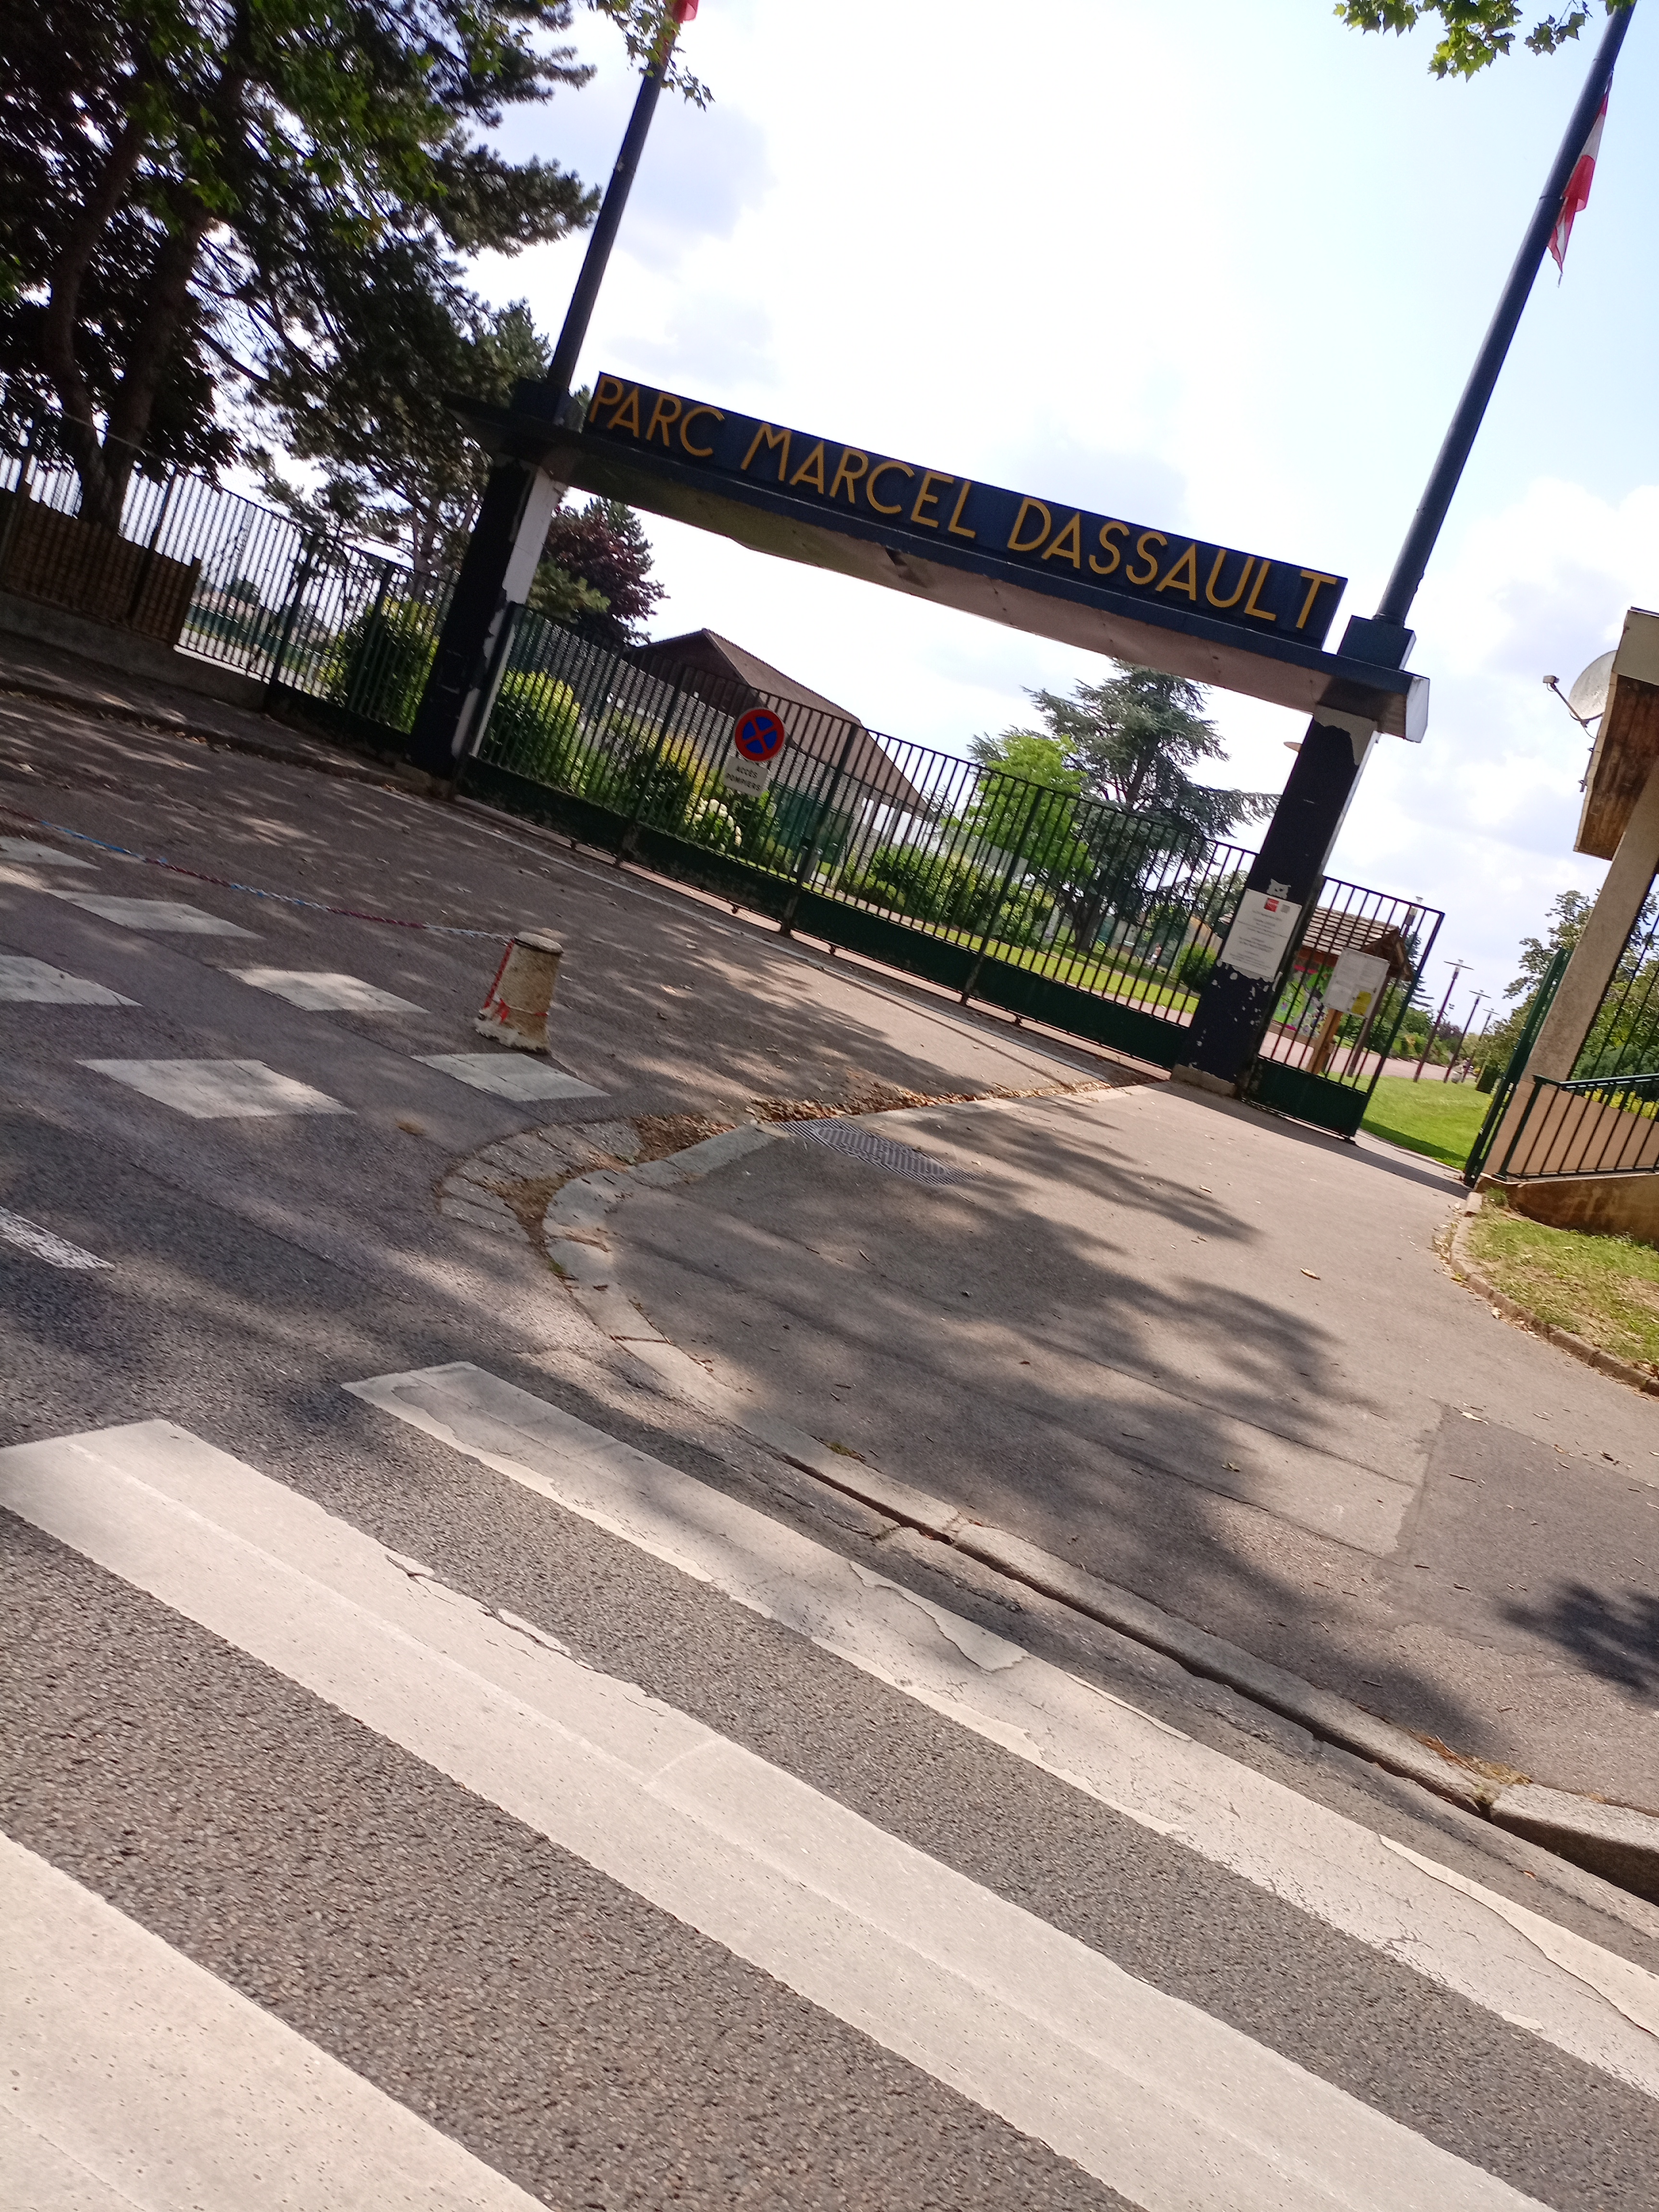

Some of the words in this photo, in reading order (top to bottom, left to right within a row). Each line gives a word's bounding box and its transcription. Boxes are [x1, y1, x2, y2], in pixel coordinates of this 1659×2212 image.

[589, 374, 725, 457] PARC
[740, 423, 976, 538] MARCEL
[1007, 497, 1337, 629] DASSAULT
[725, 772, 761, 791] POMPIERS
